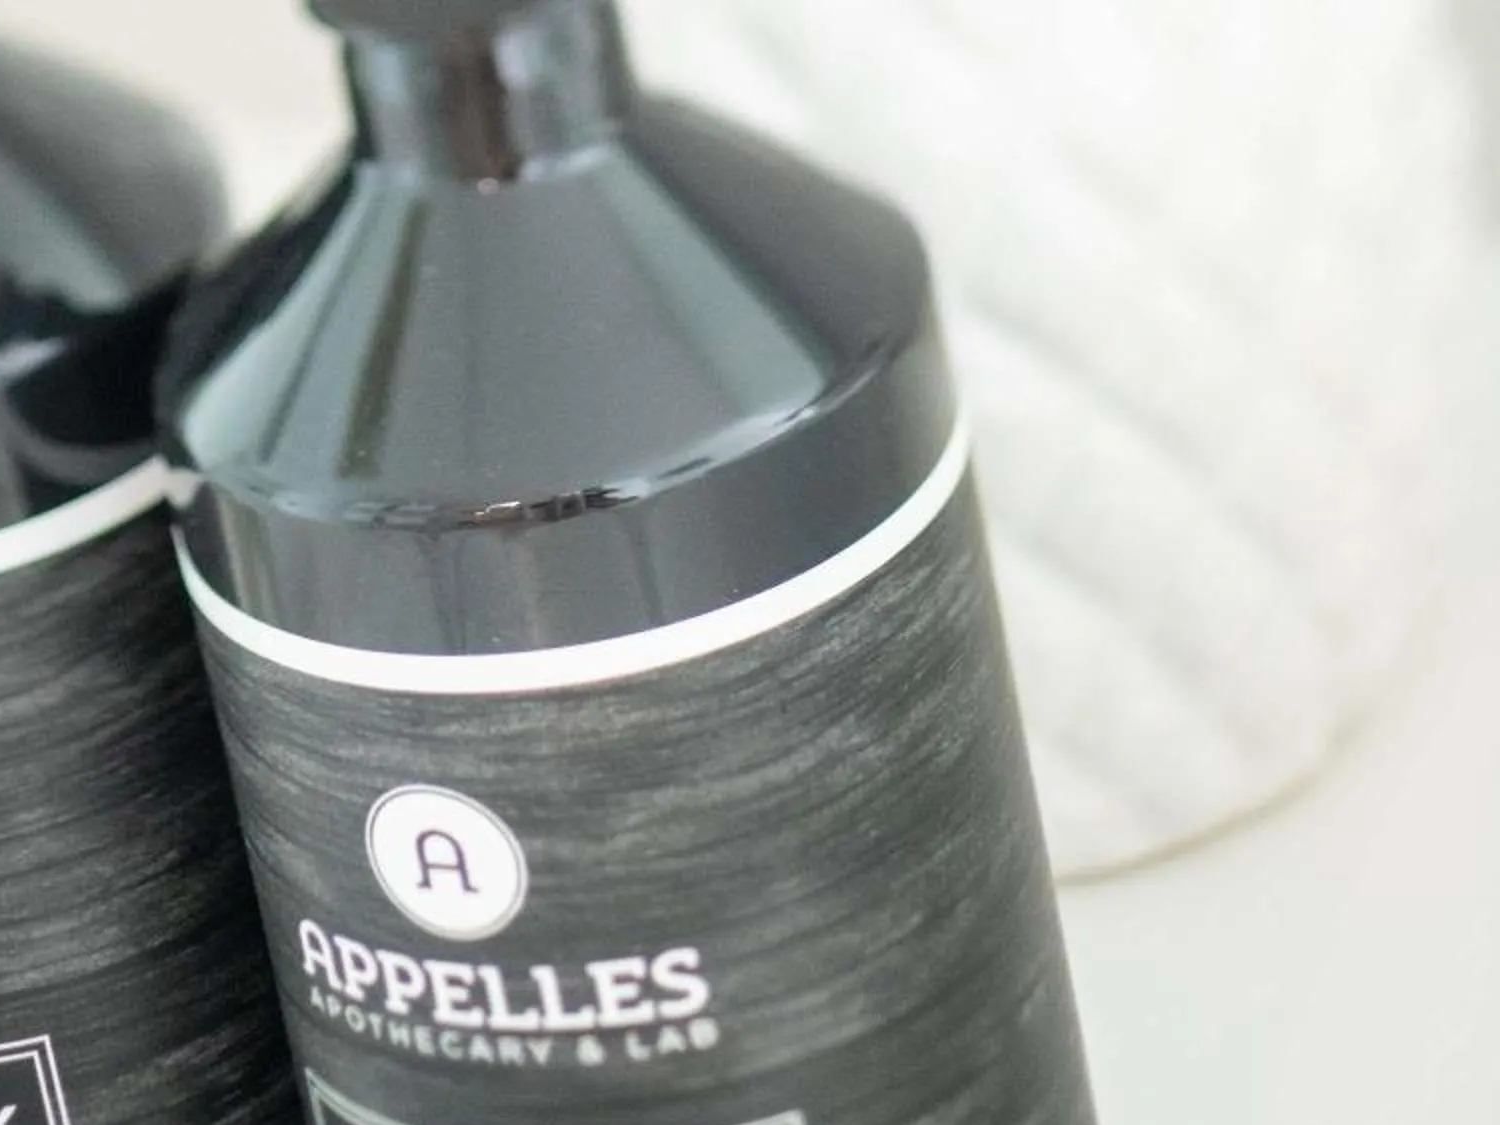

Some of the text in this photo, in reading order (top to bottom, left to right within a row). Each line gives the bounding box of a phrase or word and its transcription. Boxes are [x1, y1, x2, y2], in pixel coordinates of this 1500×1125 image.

[415, 828, 480, 894] A
[299, 917, 711, 1033] APPELLES
[310, 986, 721, 1067] APOTHECARY & LAB
